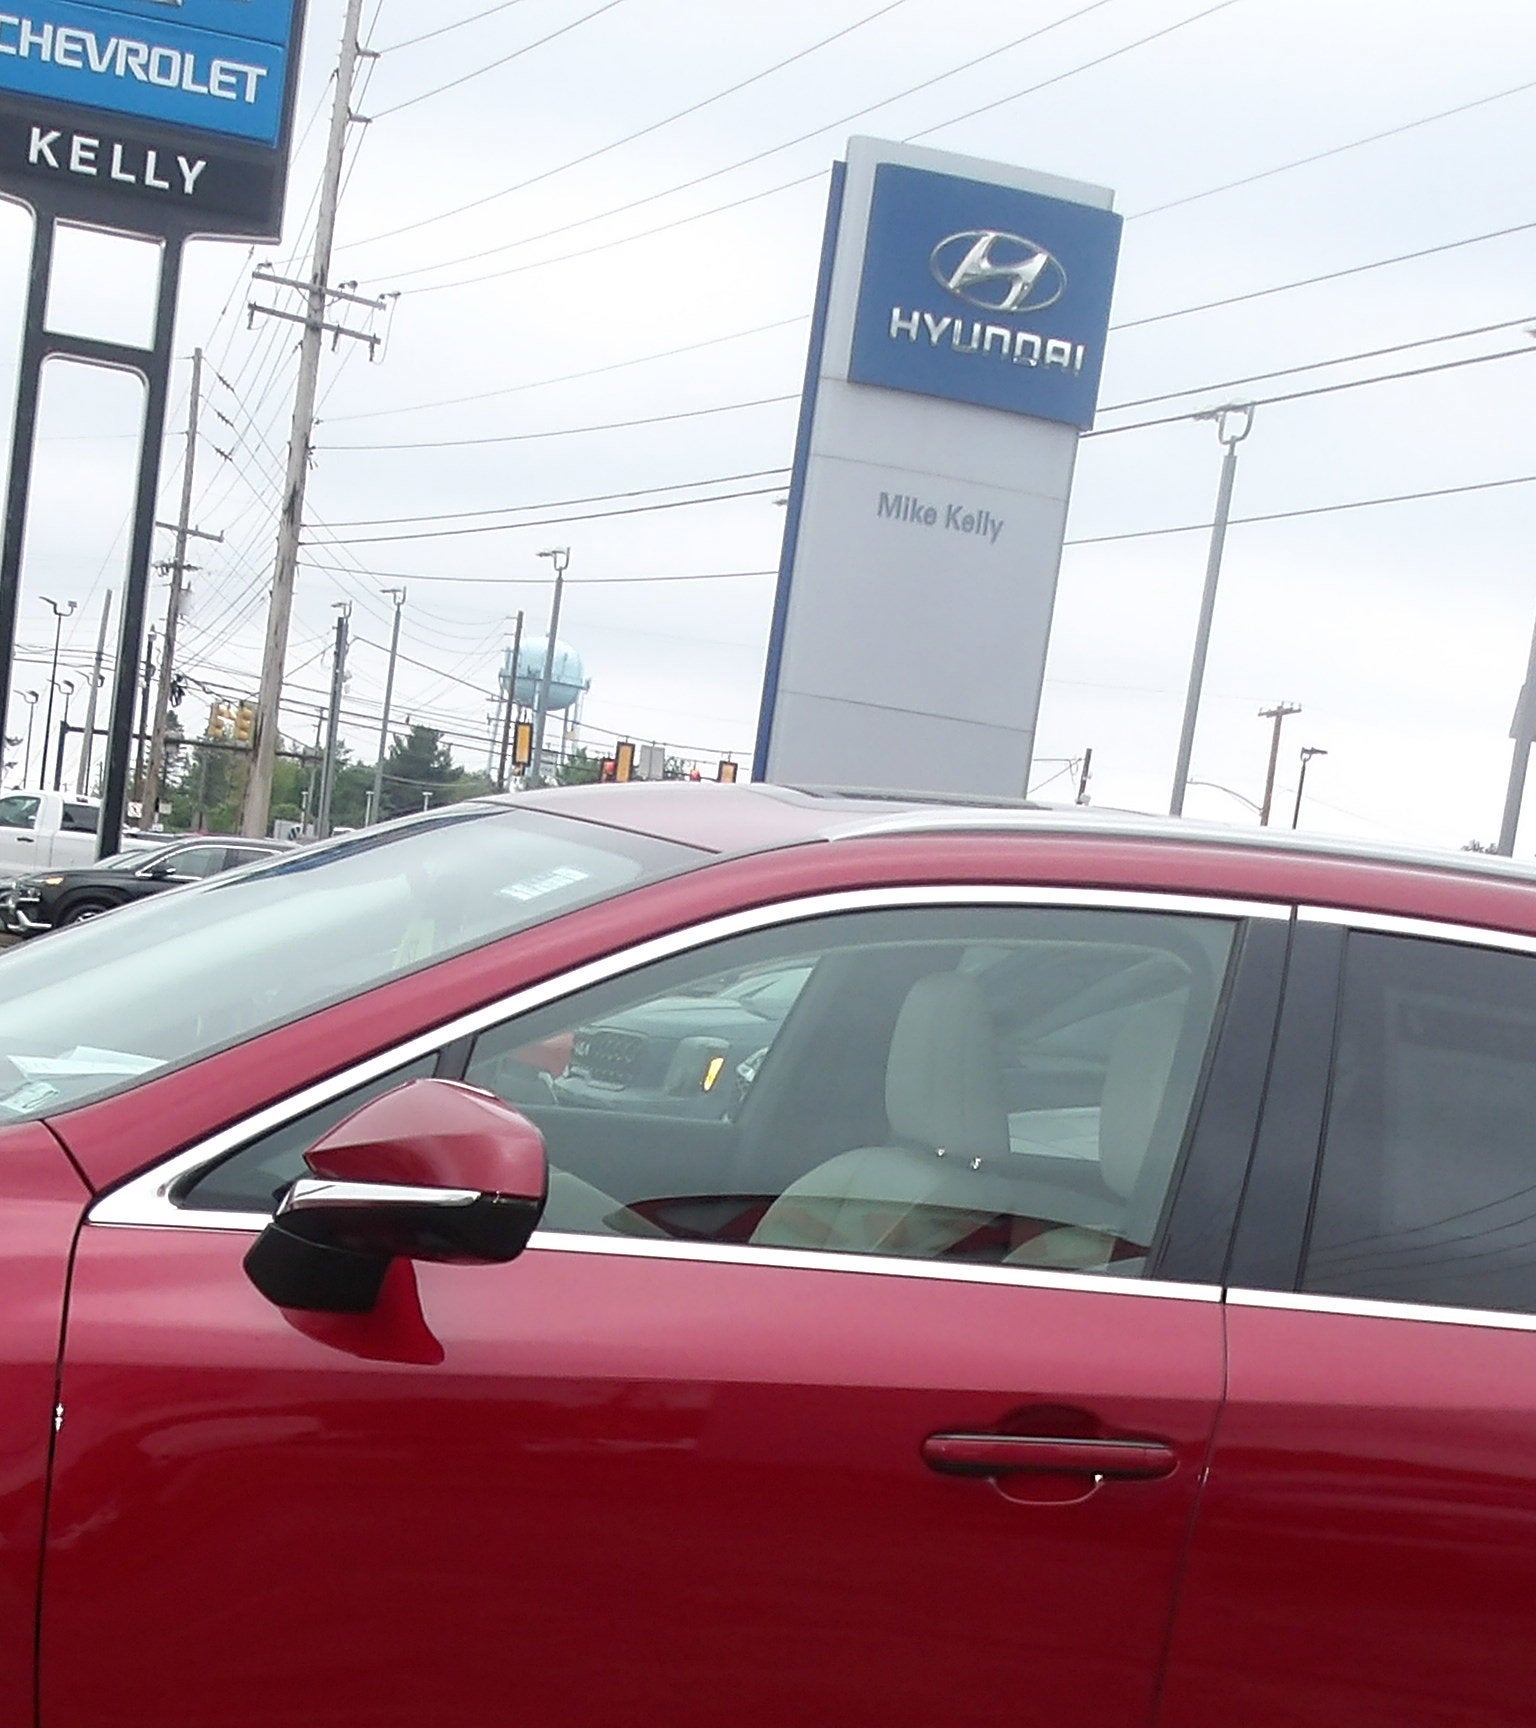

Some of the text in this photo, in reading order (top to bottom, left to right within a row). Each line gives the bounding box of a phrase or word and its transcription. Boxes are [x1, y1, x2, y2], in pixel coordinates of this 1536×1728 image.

[28, 126, 207, 195] KELLY
[889, 306, 1085, 376] HYUNDAI
[877, 491, 1004, 544] Mike Kelly
